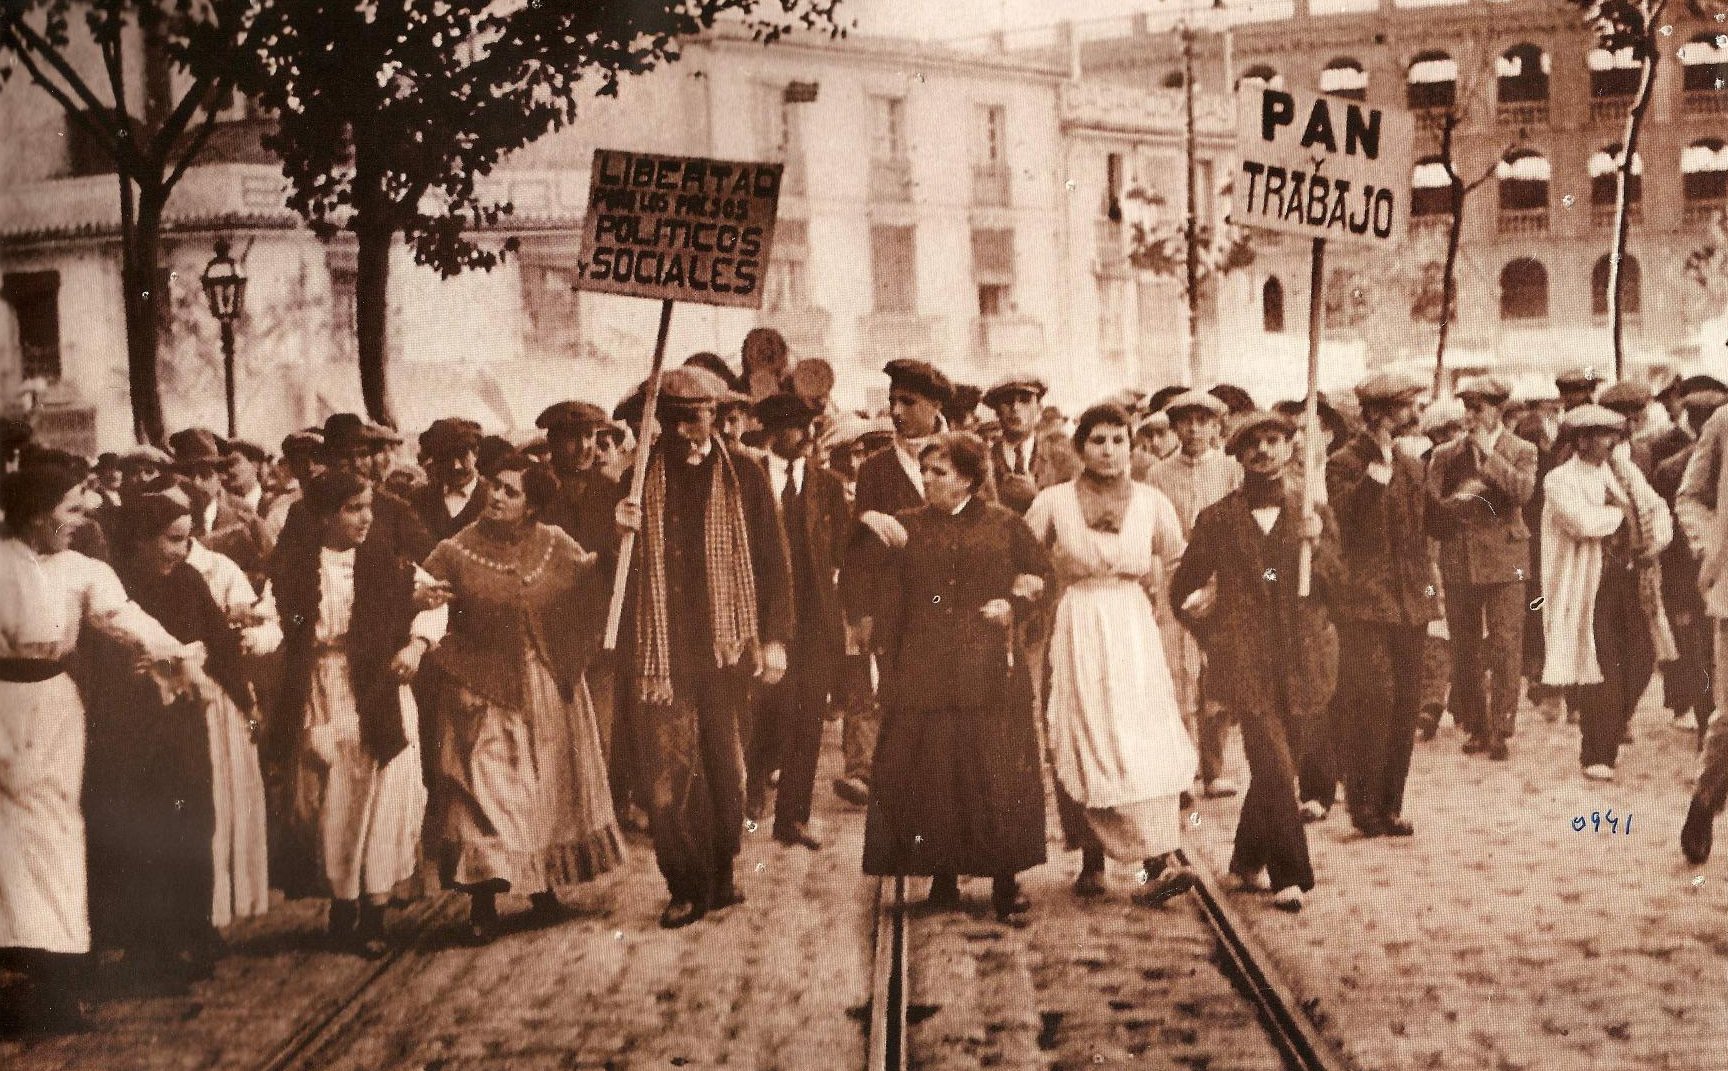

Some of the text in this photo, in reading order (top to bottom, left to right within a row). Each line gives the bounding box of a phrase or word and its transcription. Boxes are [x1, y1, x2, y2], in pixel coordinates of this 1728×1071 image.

[1262, 89, 1382, 160] PAN
[600, 153, 777, 197] LIBERTAD
[1311, 155, 1325, 174] Y
[639, 191, 669, 213] LOS
[1242, 160, 1394, 239] TRABAJO
[595, 214, 763, 257] POLITICOS
[590, 247, 760, 295] SOCIALES
